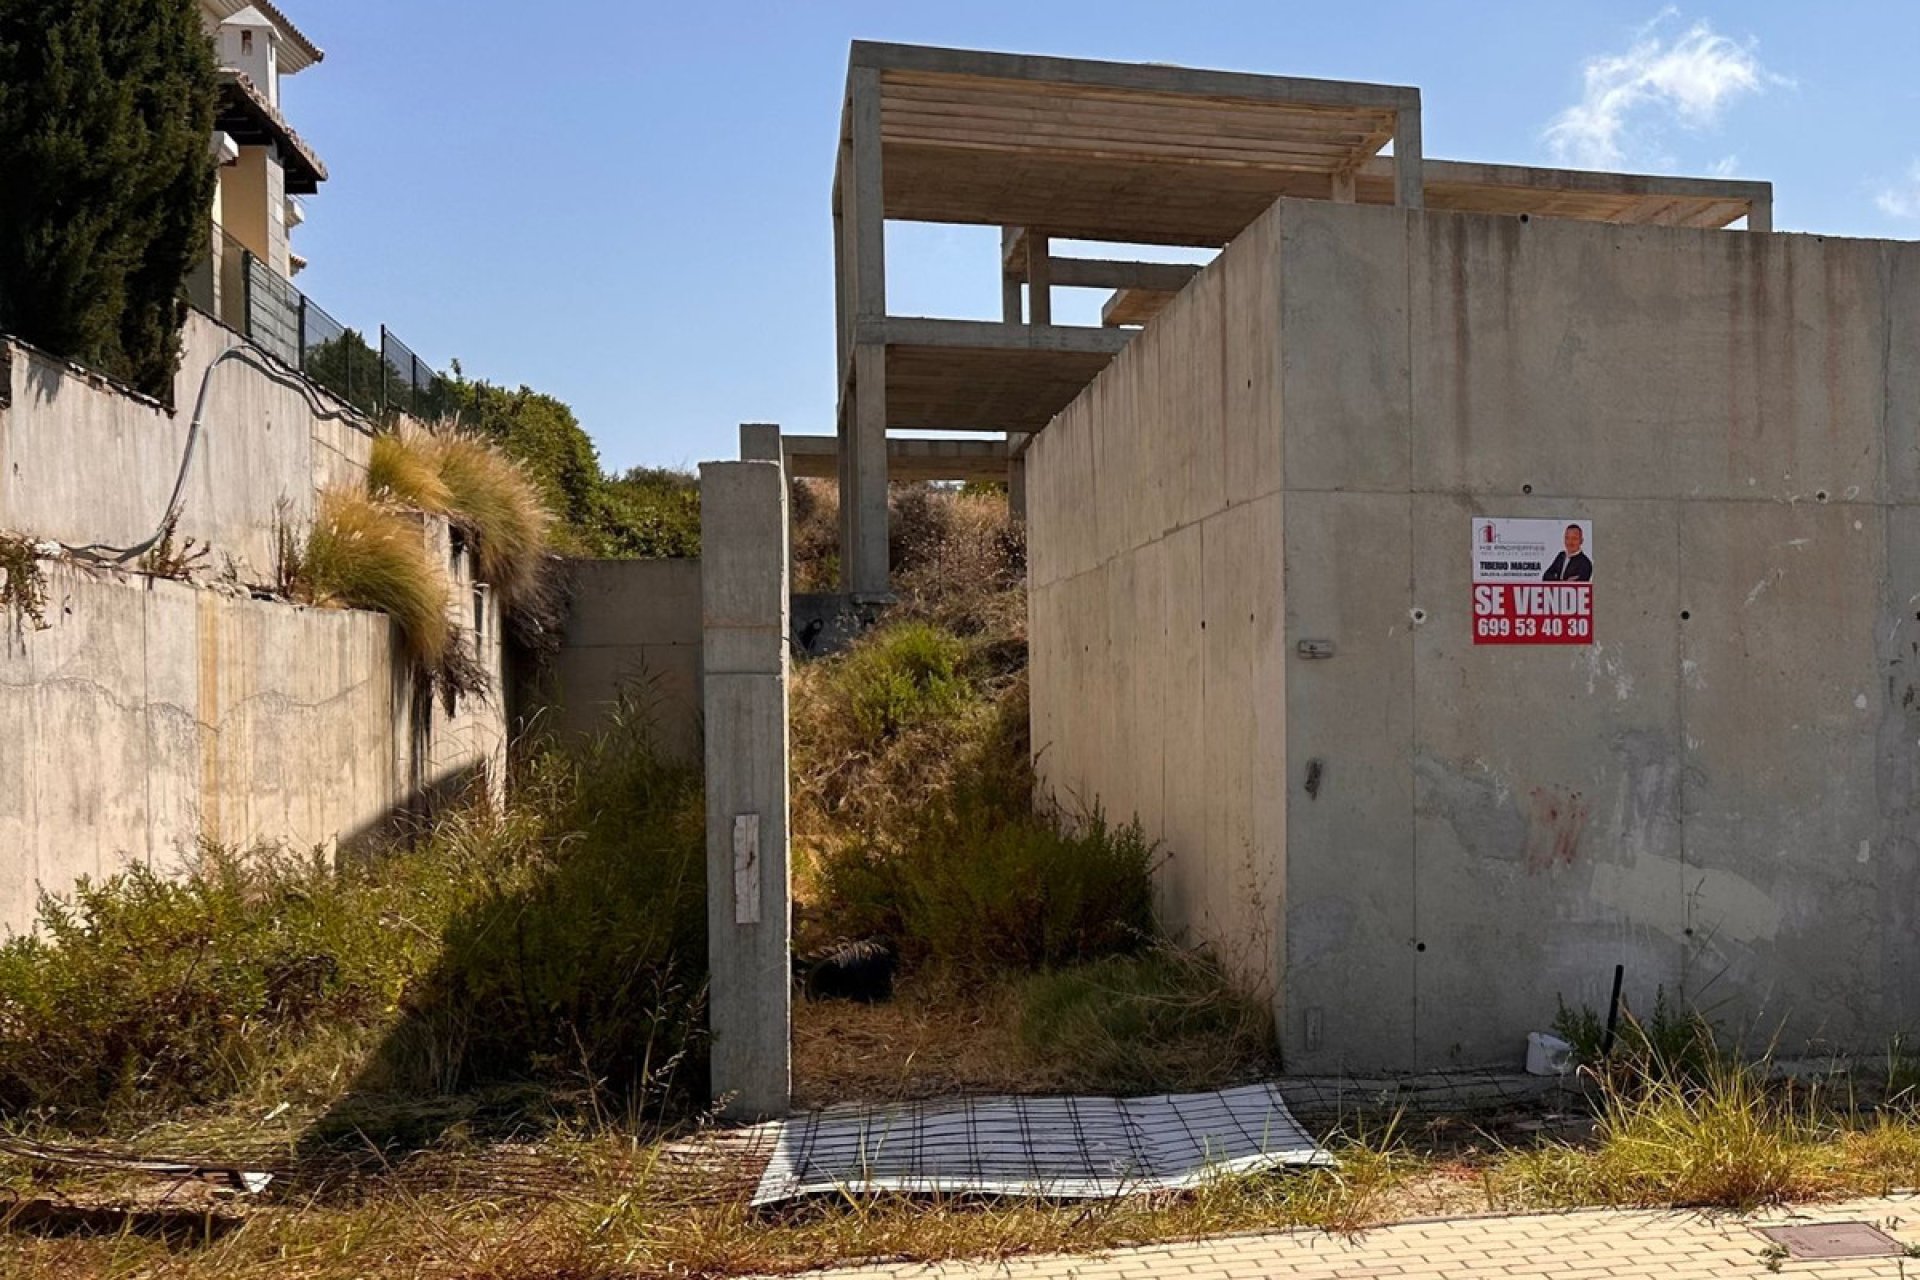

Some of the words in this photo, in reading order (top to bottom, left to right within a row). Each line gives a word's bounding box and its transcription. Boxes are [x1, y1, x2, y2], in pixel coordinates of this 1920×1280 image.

[1475, 586, 1505, 615] SE
[1512, 586, 1590, 616] VENDE
[1478, 618, 1510, 636] 699
[1514, 618, 1537, 636] 53
[1541, 618, 1563, 636] 40
[1567, 618, 1588, 636] 30
